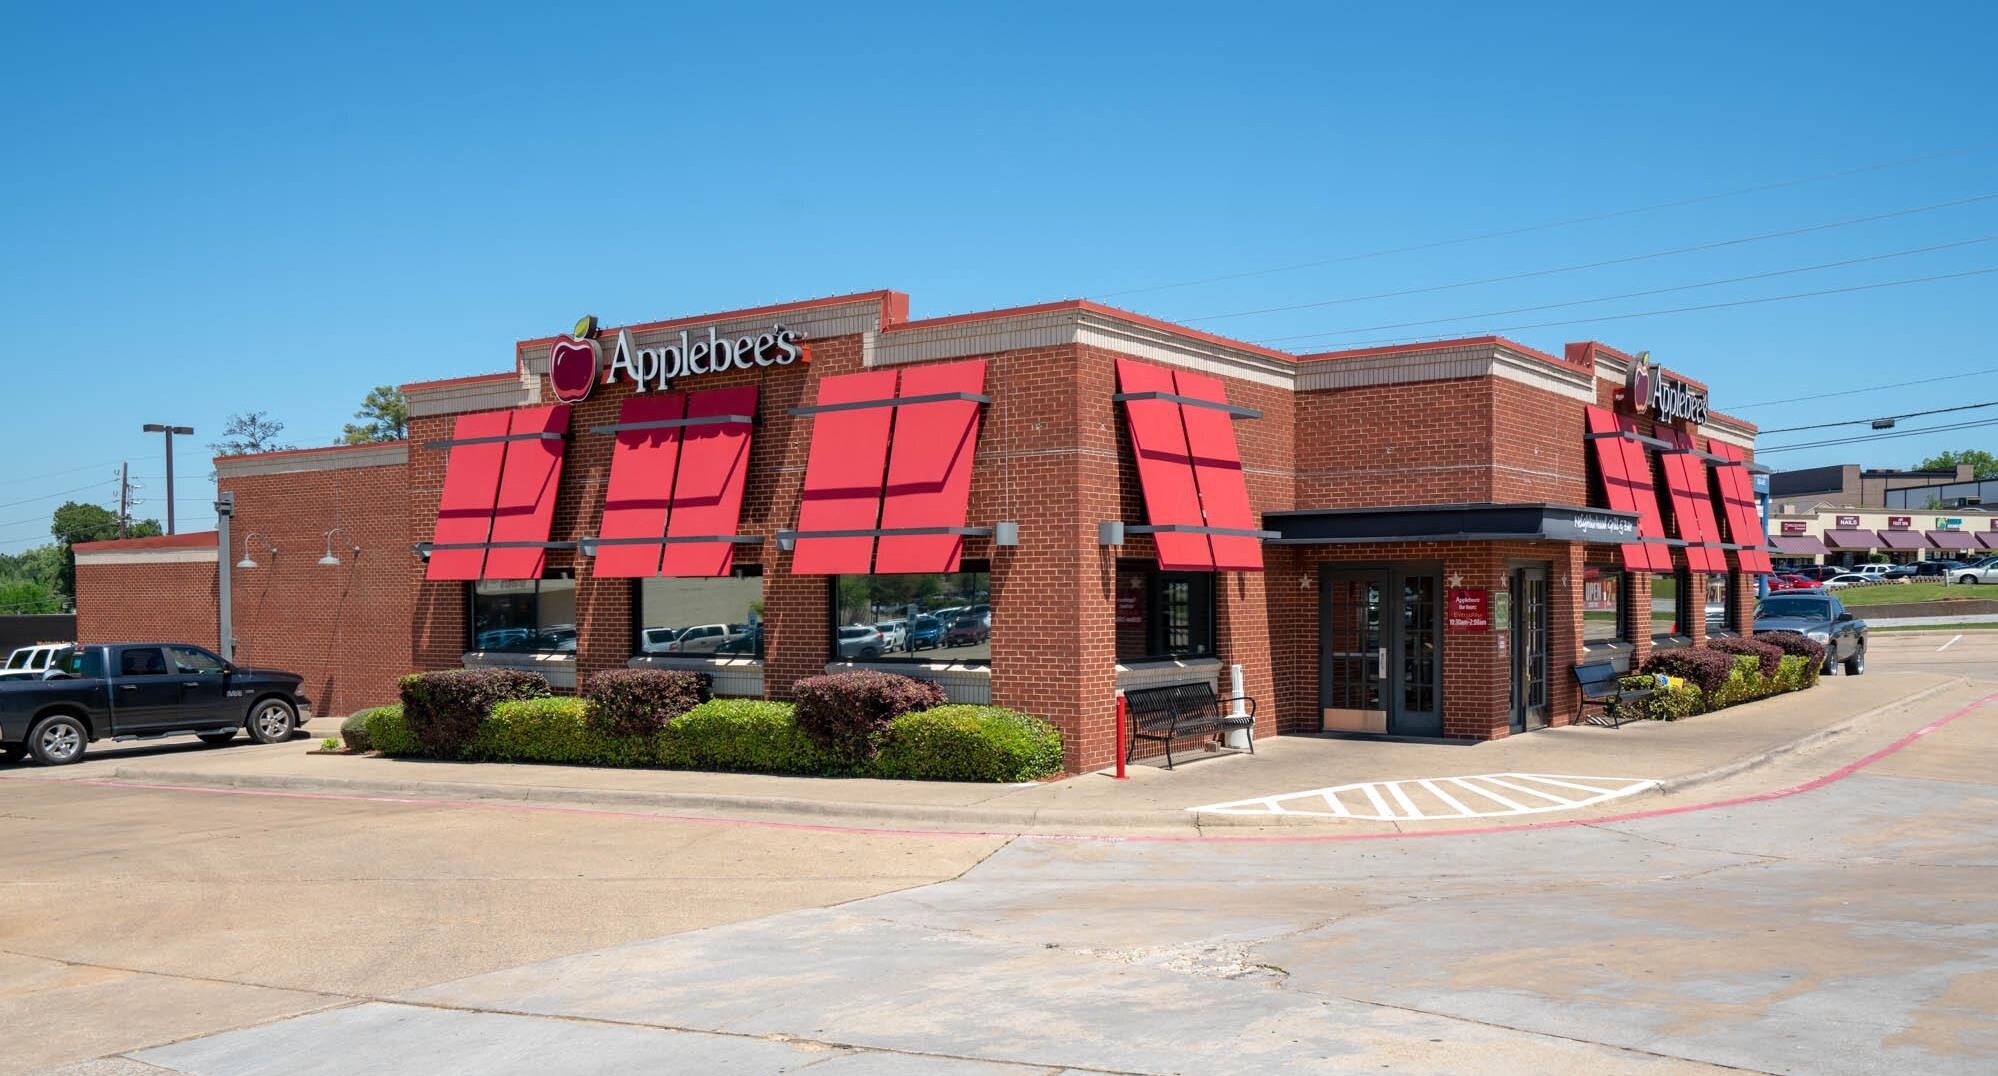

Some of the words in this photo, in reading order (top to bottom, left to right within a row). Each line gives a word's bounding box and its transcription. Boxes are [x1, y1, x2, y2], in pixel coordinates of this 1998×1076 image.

[607, 323, 801, 392] Applebee's
[1651, 363, 1709, 425] Applebee's
[1585, 582, 1602, 601] OPEN
